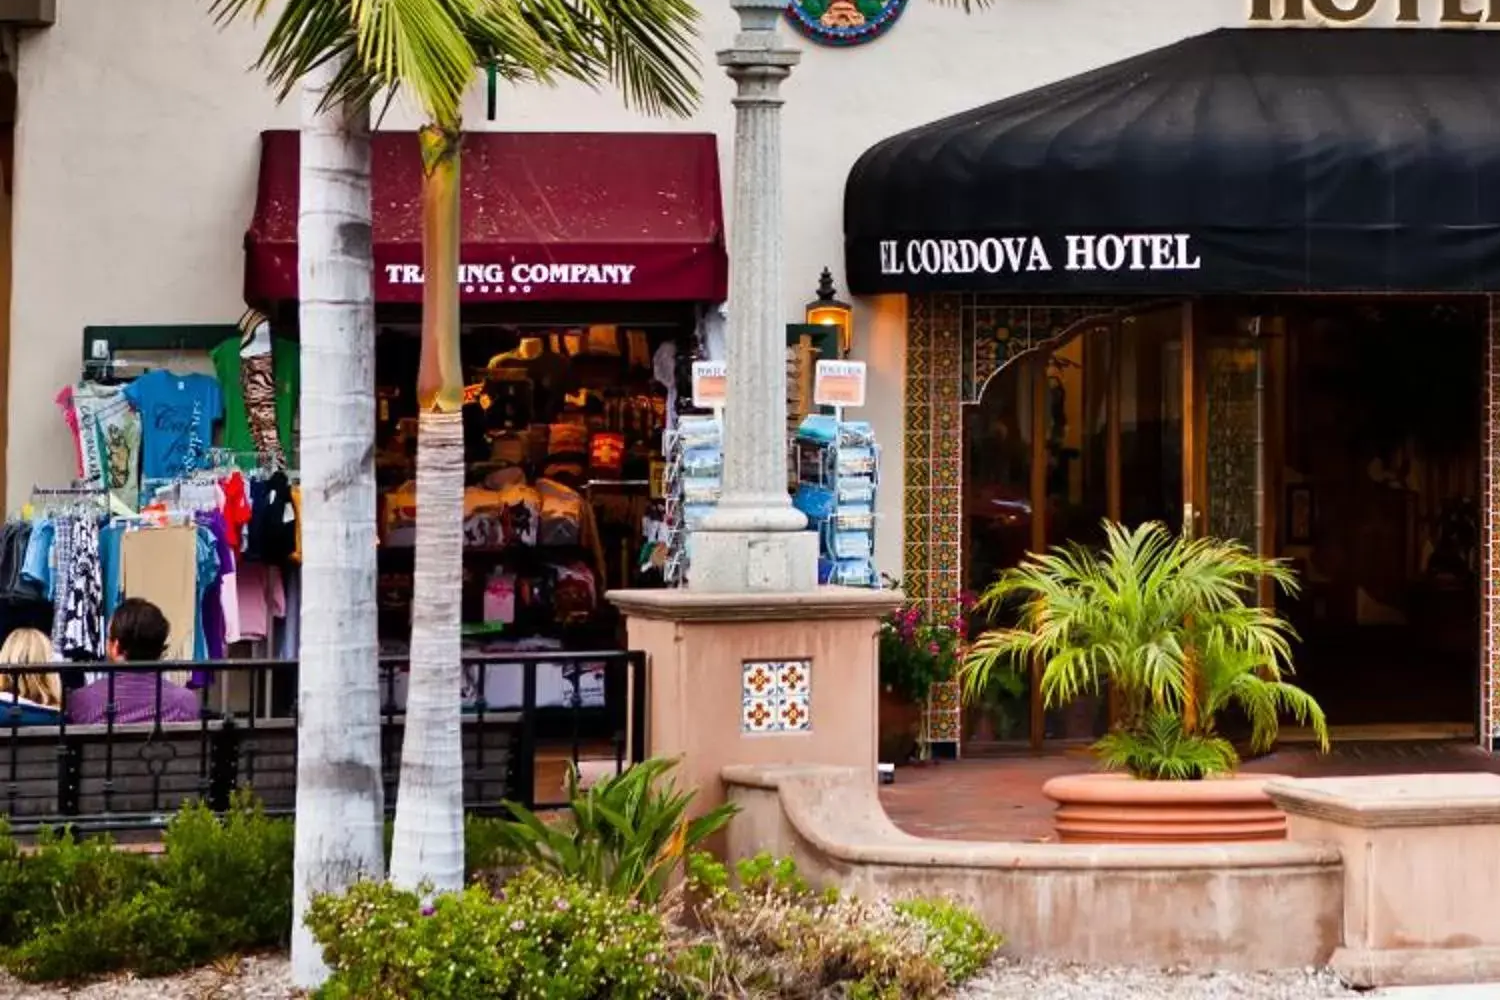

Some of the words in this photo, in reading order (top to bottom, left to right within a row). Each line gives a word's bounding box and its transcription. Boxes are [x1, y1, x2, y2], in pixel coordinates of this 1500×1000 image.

[879, 239, 904, 273] EL
[906, 236, 1052, 273] CORDOVA
[1064, 233, 1201, 270] HOTEL
[385, 263, 504, 284] TRING
[511, 263, 636, 284] COMPANY
